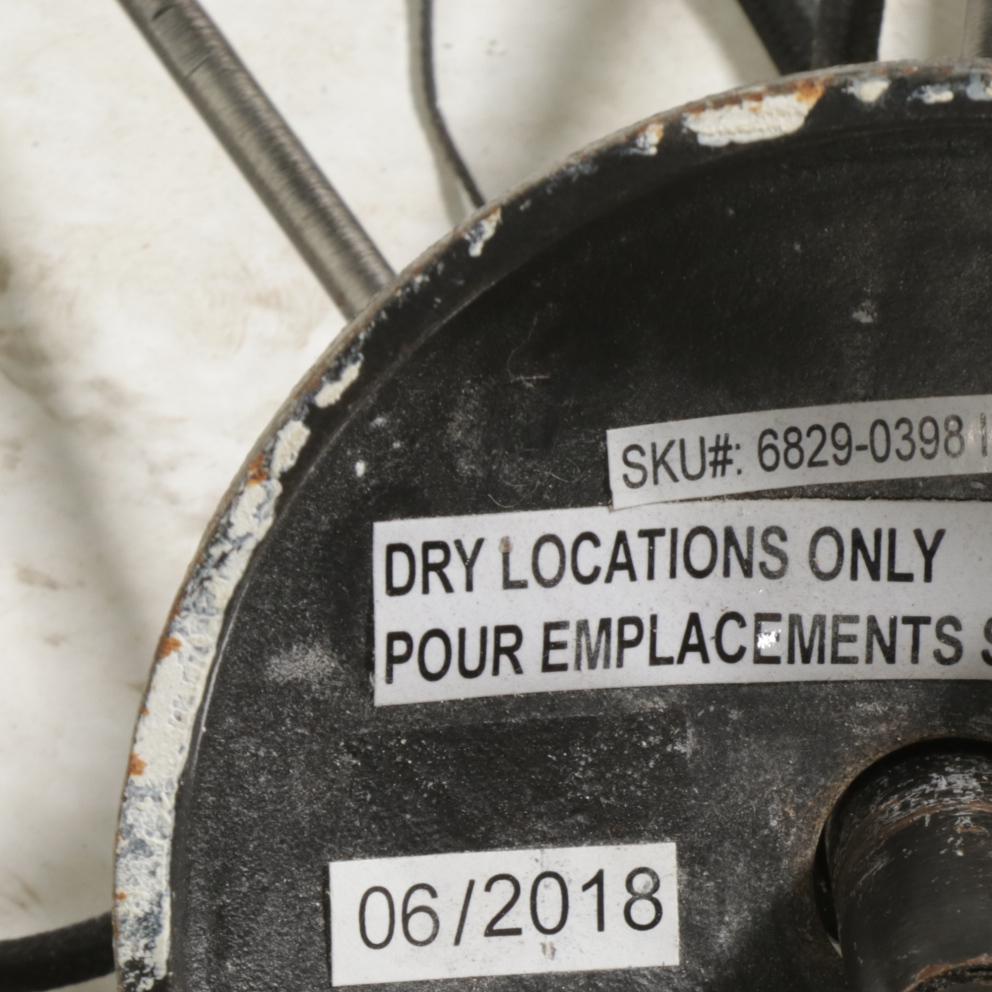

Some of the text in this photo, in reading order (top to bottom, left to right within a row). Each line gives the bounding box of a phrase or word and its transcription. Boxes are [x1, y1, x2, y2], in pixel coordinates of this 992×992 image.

[622, 433, 743, 490] SKU#:
[757, 415, 966, 473] 6829-0398
[384, 525, 946, 597] DRY LOCATIONS ONLY
[385, 624, 524, 685] POUR
[541, 611, 963, 674] EMPLACEMENTS
[358, 866, 663, 950] 06/2018
